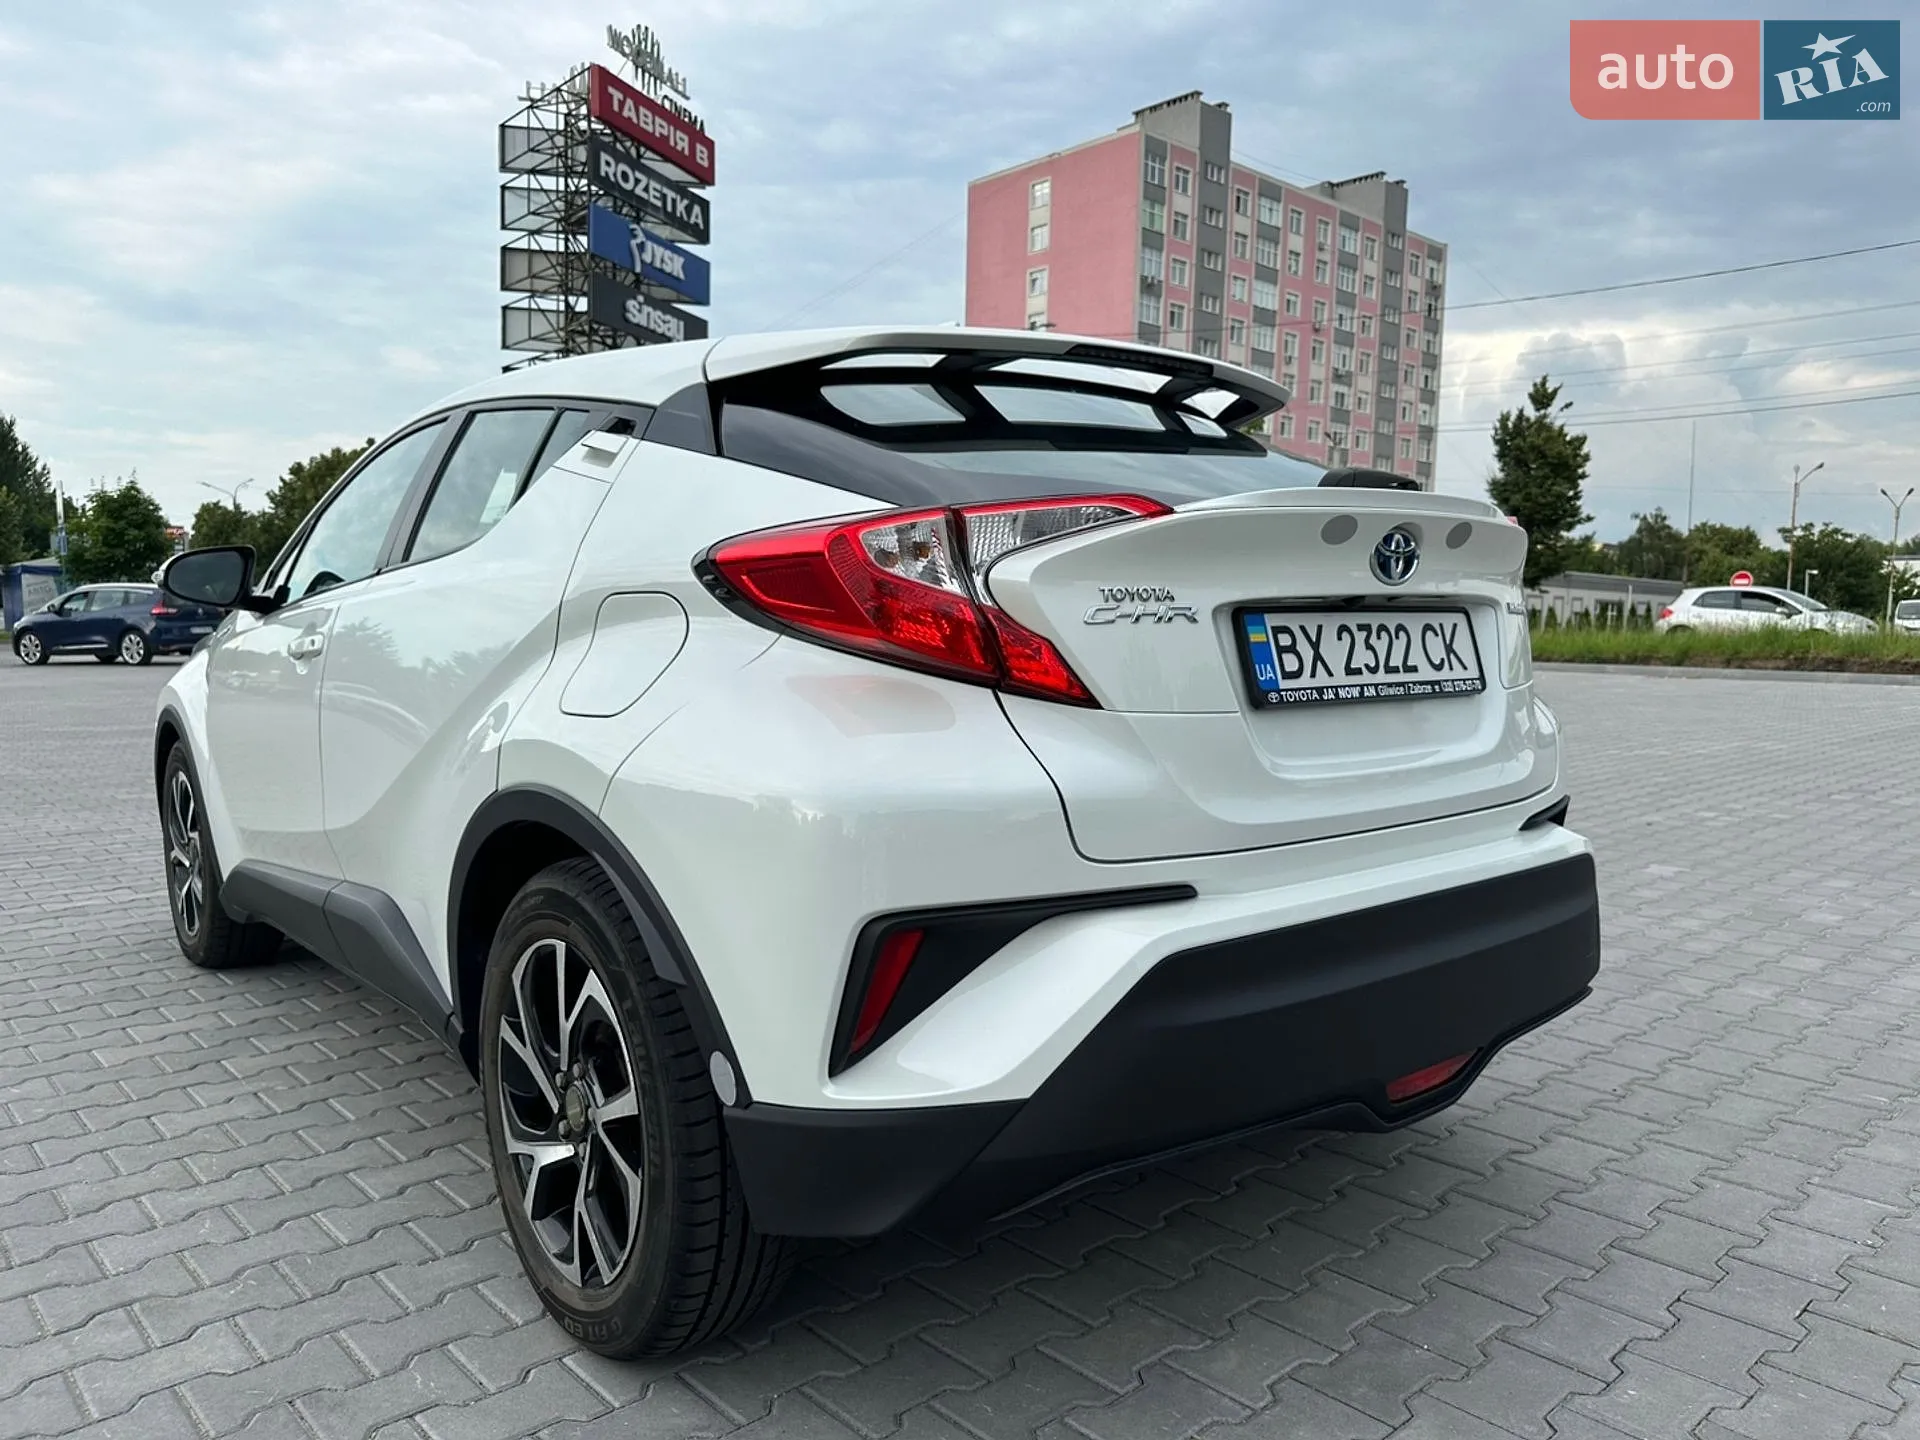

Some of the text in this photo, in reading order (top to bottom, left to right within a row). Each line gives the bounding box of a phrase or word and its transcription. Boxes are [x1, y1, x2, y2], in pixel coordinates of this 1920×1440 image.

[607, 85, 689, 156] ТАВРІЯ
[600, 151, 704, 230] ROZETKA
[641, 239, 686, 280] JYSK
[1098, 586, 1175, 603] TOYOTA
[1083, 604, 1199, 625] C-HR
[1270, 622, 1469, 680] BX 2322 CK
[1255, 664, 1276, 681] UA
[1281, 689, 1320, 702] TOYOTA
[1364, 685, 1376, 697] AN
[1378, 684, 1405, 696] Gliwice
[1409, 682, 1433, 694] Zabrze
